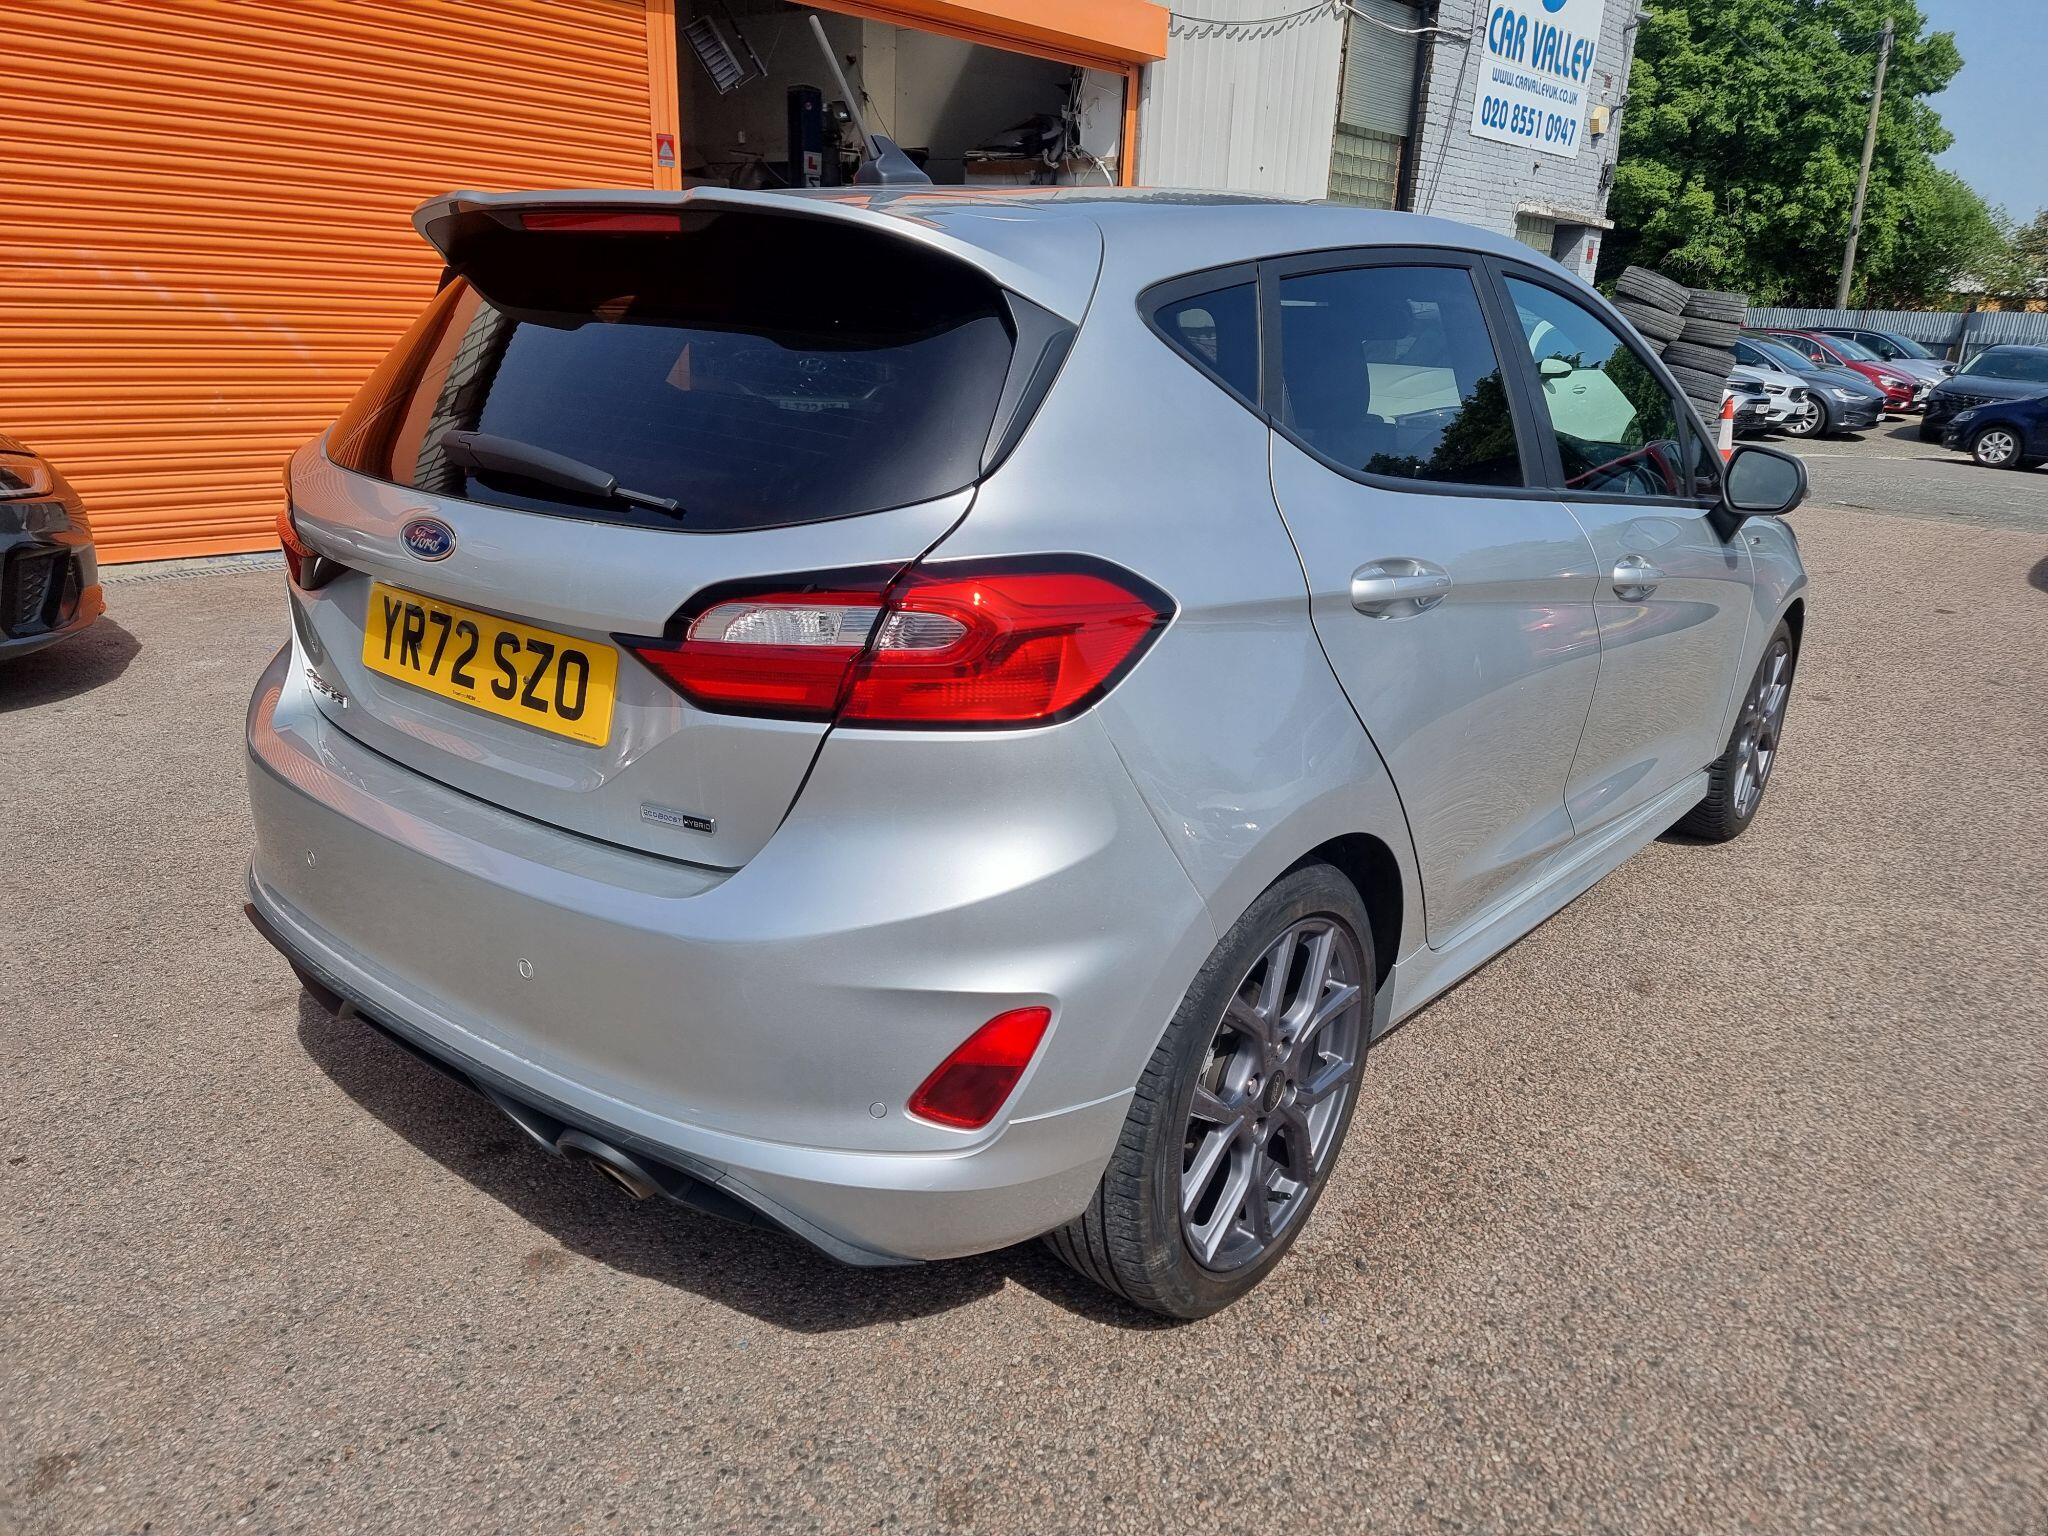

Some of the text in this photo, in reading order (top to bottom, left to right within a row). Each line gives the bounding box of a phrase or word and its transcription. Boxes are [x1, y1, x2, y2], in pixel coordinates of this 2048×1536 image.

[1489, 6, 1595, 84] CAR VALLEY
[1481, 95, 1577, 147] 020 8551 0947
[808, 155, 818, 171] L
[409, 526, 443, 552] Ford
[383, 595, 480, 690] YR72
[490, 631, 590, 722] SZO
[683, 818, 711, 831] HYBRID
